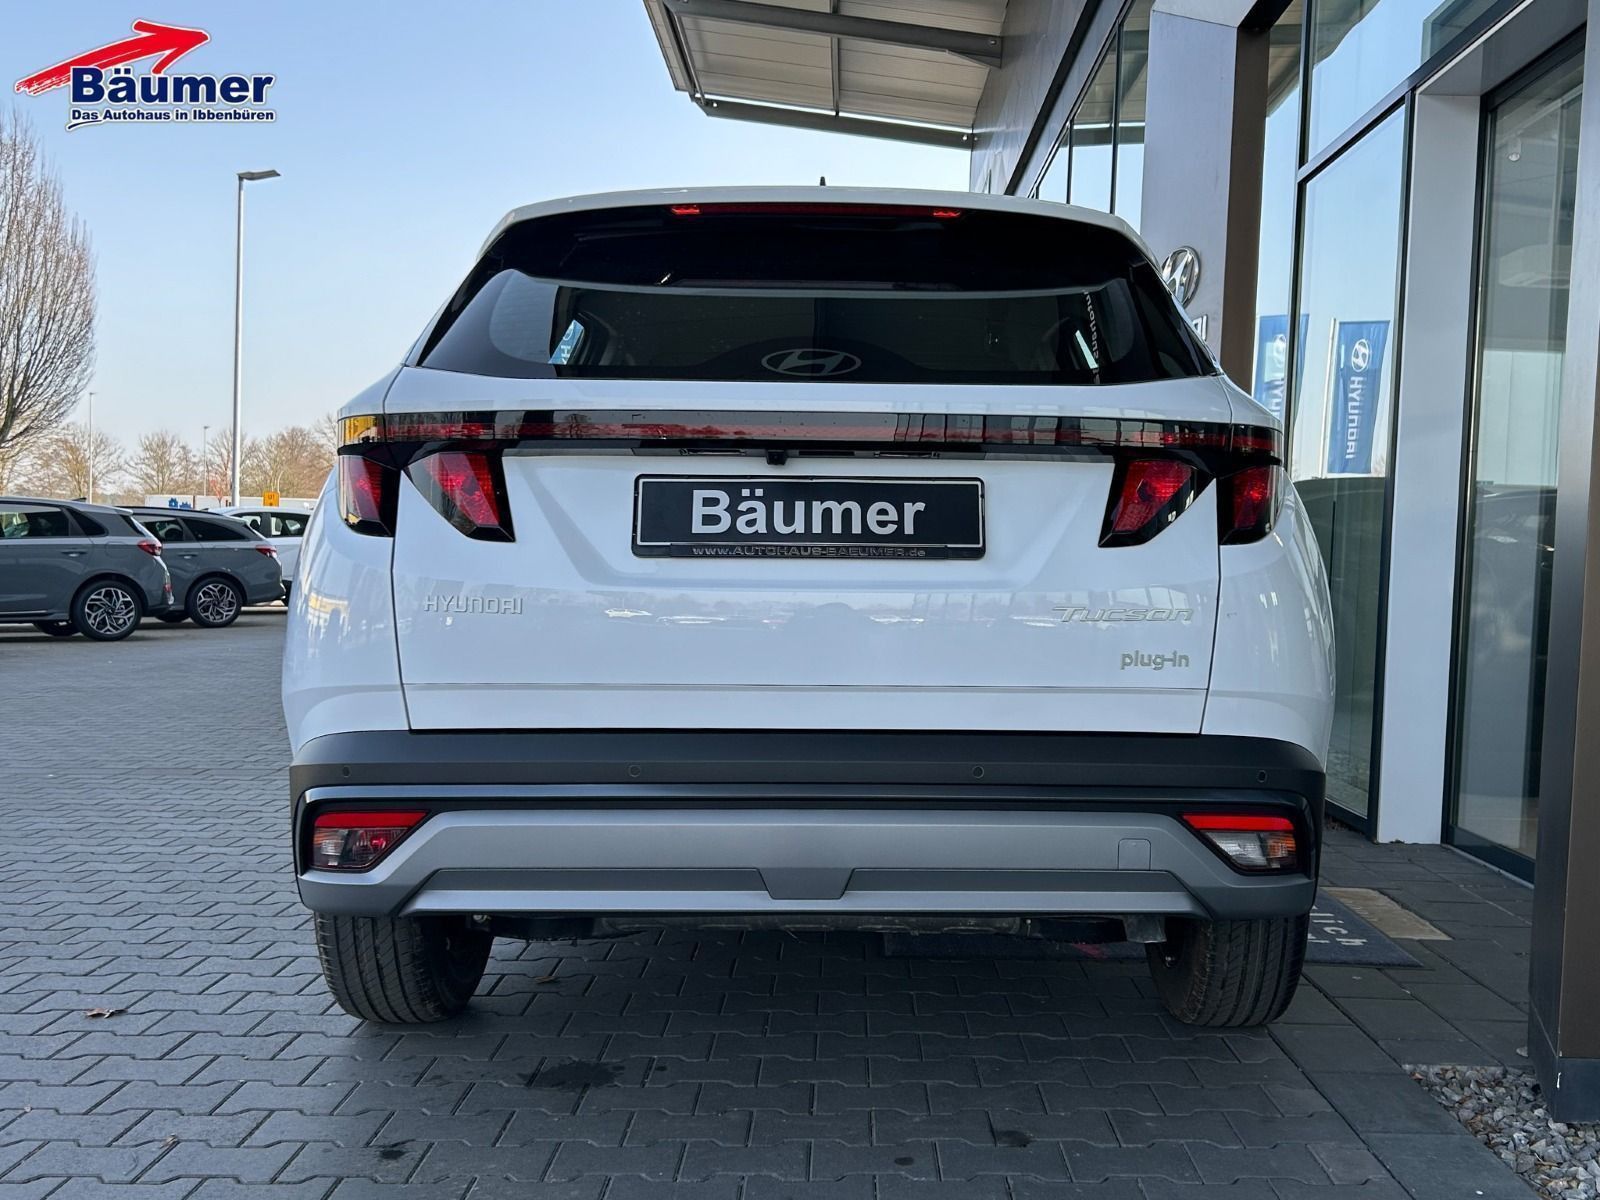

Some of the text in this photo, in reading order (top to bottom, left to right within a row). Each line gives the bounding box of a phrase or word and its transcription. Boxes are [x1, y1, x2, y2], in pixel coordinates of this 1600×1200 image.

[1345, 376, 1365, 459] HYUNDAI
[691, 488, 926, 535] Bäumer
[424, 595, 523, 615] HYUNDAI
[1120, 650, 1190, 670] plug-in
